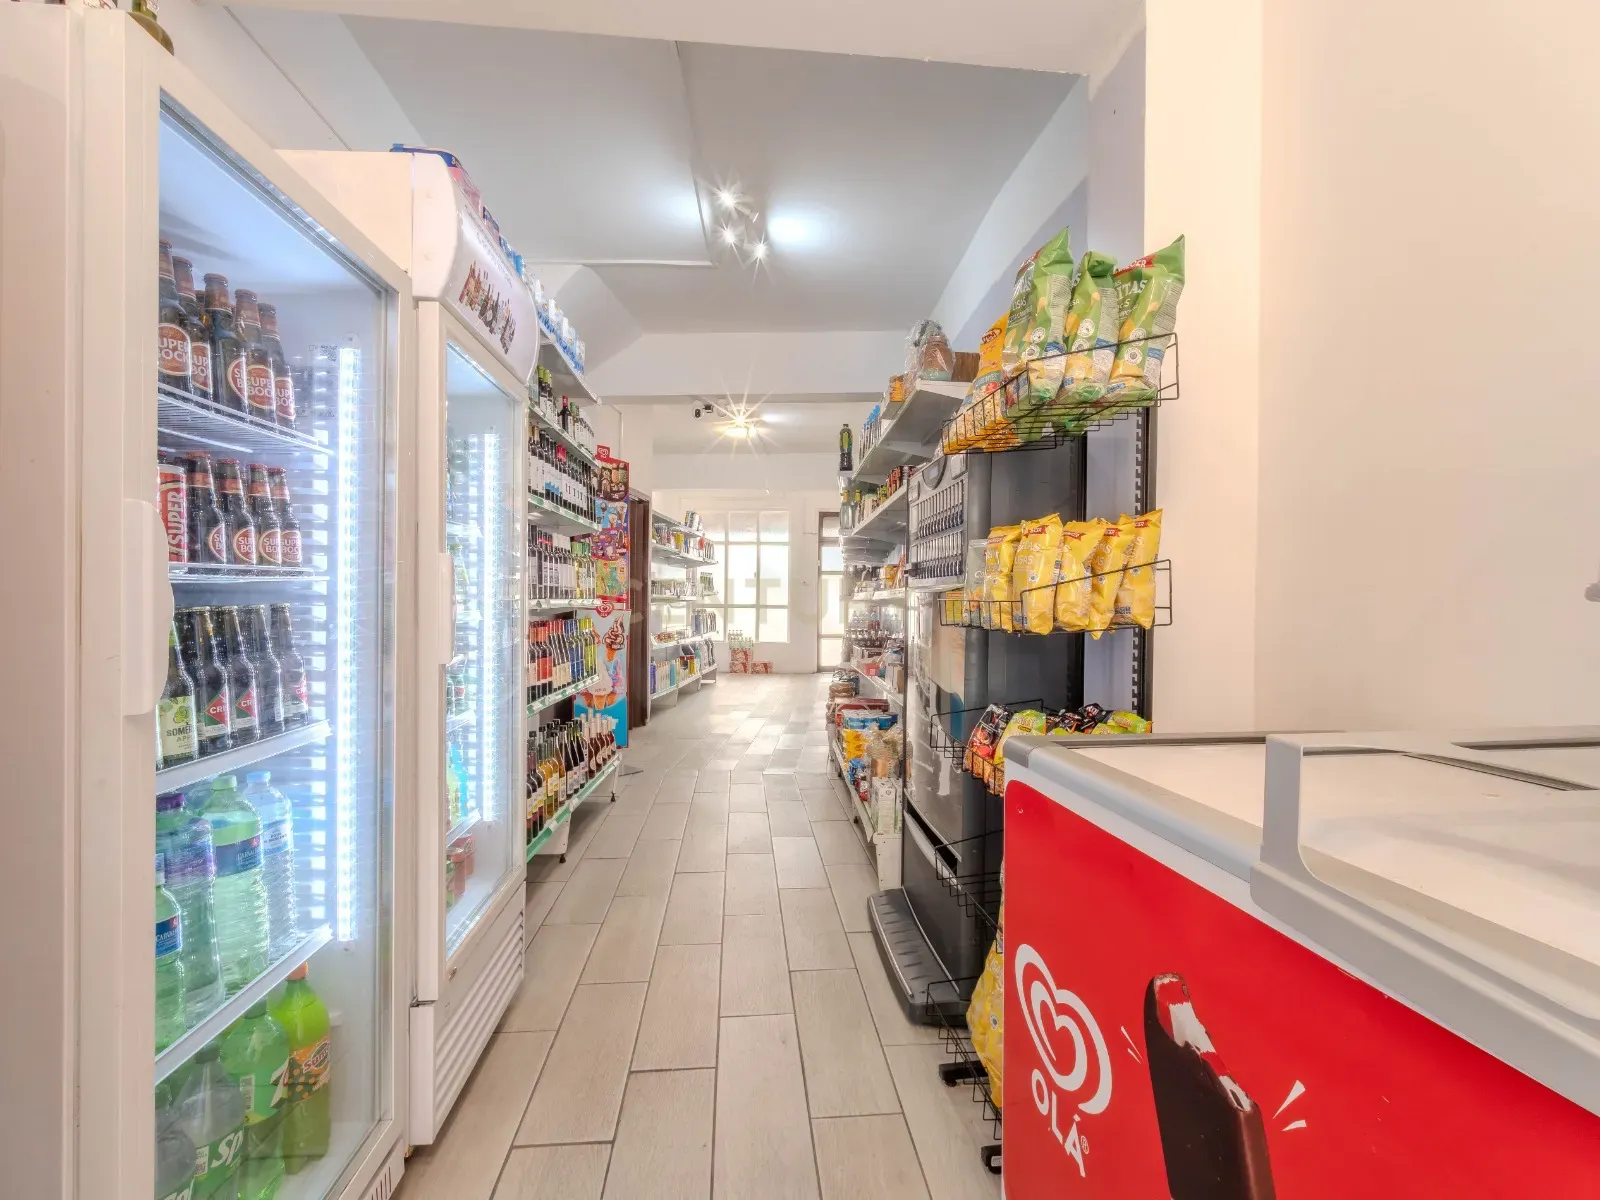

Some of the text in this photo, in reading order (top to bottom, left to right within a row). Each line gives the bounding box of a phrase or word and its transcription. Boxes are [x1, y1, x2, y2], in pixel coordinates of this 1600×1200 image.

[247, 376, 273, 388] SUPE
[248, 386, 274, 398] BOC
[168, 491, 184, 545] SUPER
